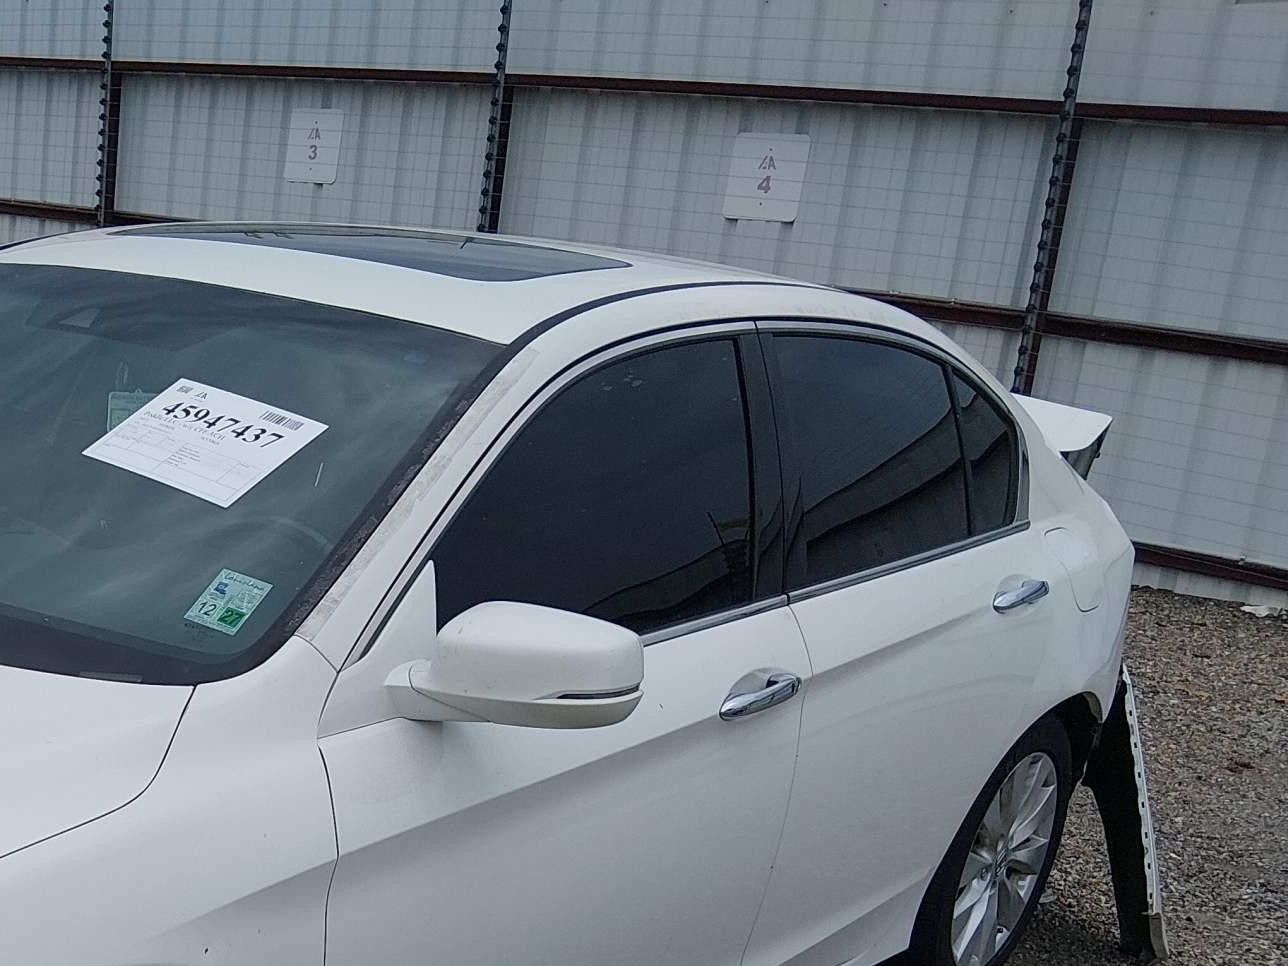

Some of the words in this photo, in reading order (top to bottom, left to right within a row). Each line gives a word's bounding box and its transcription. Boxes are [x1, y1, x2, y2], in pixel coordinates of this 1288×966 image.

[308, 145, 318, 160] 3
[757, 175, 772, 193] 4
[162, 402, 285, 448] 45947437
[198, 600, 217, 616] 12
[222, 609, 244, 628] 27
